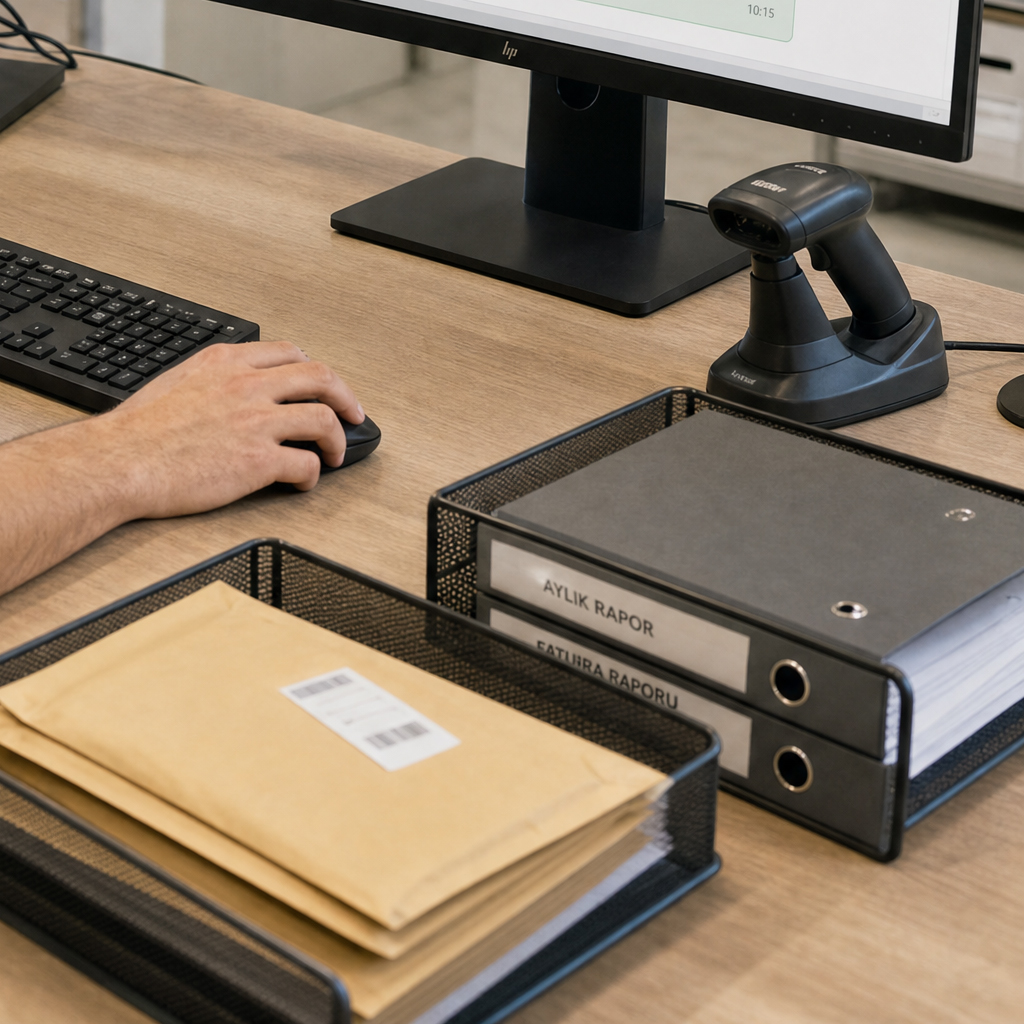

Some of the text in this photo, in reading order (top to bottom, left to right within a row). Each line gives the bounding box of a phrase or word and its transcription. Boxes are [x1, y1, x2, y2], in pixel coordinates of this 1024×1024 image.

[747, 4, 775, 19] 10:15
[543, 580, 654, 638] AYLIK RAPOR
[609, 667, 679, 710] RAPORU
